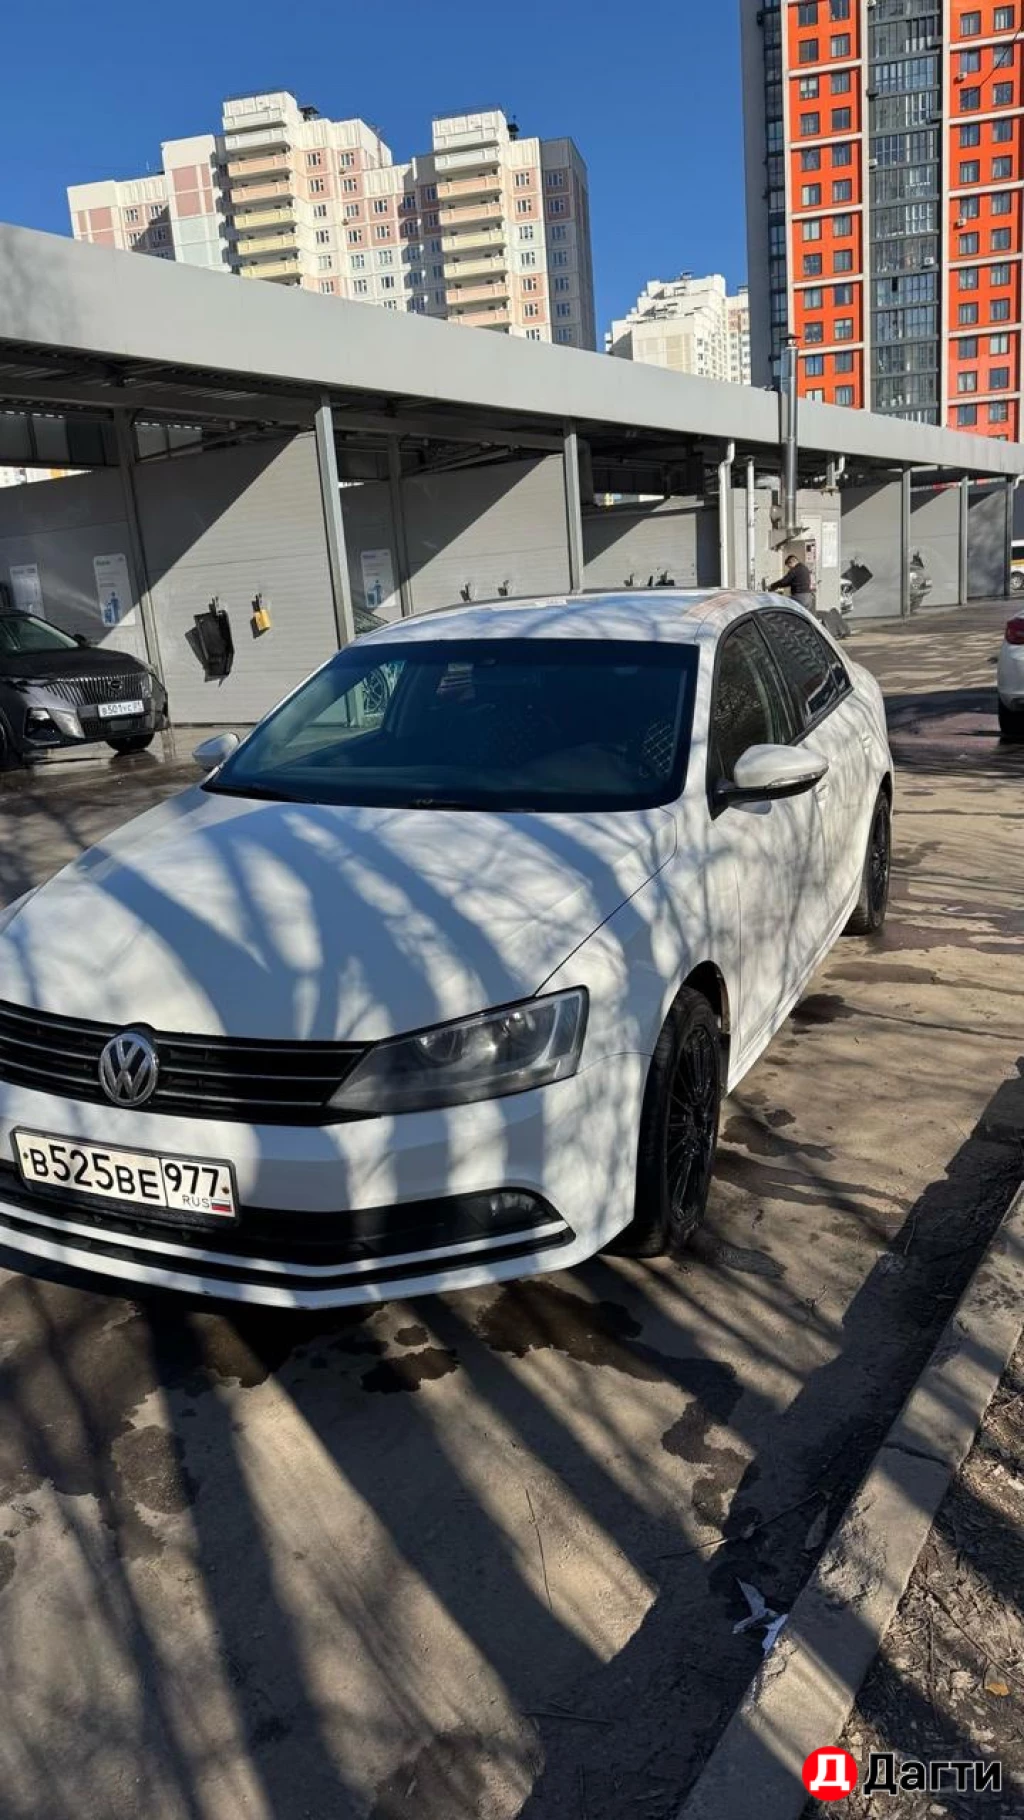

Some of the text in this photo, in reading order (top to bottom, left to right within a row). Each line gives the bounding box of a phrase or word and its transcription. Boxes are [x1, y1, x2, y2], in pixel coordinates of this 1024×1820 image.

[30, 1145, 218, 1199] В525ВЕ 977
[182, 1195, 210, 1208] RUS
